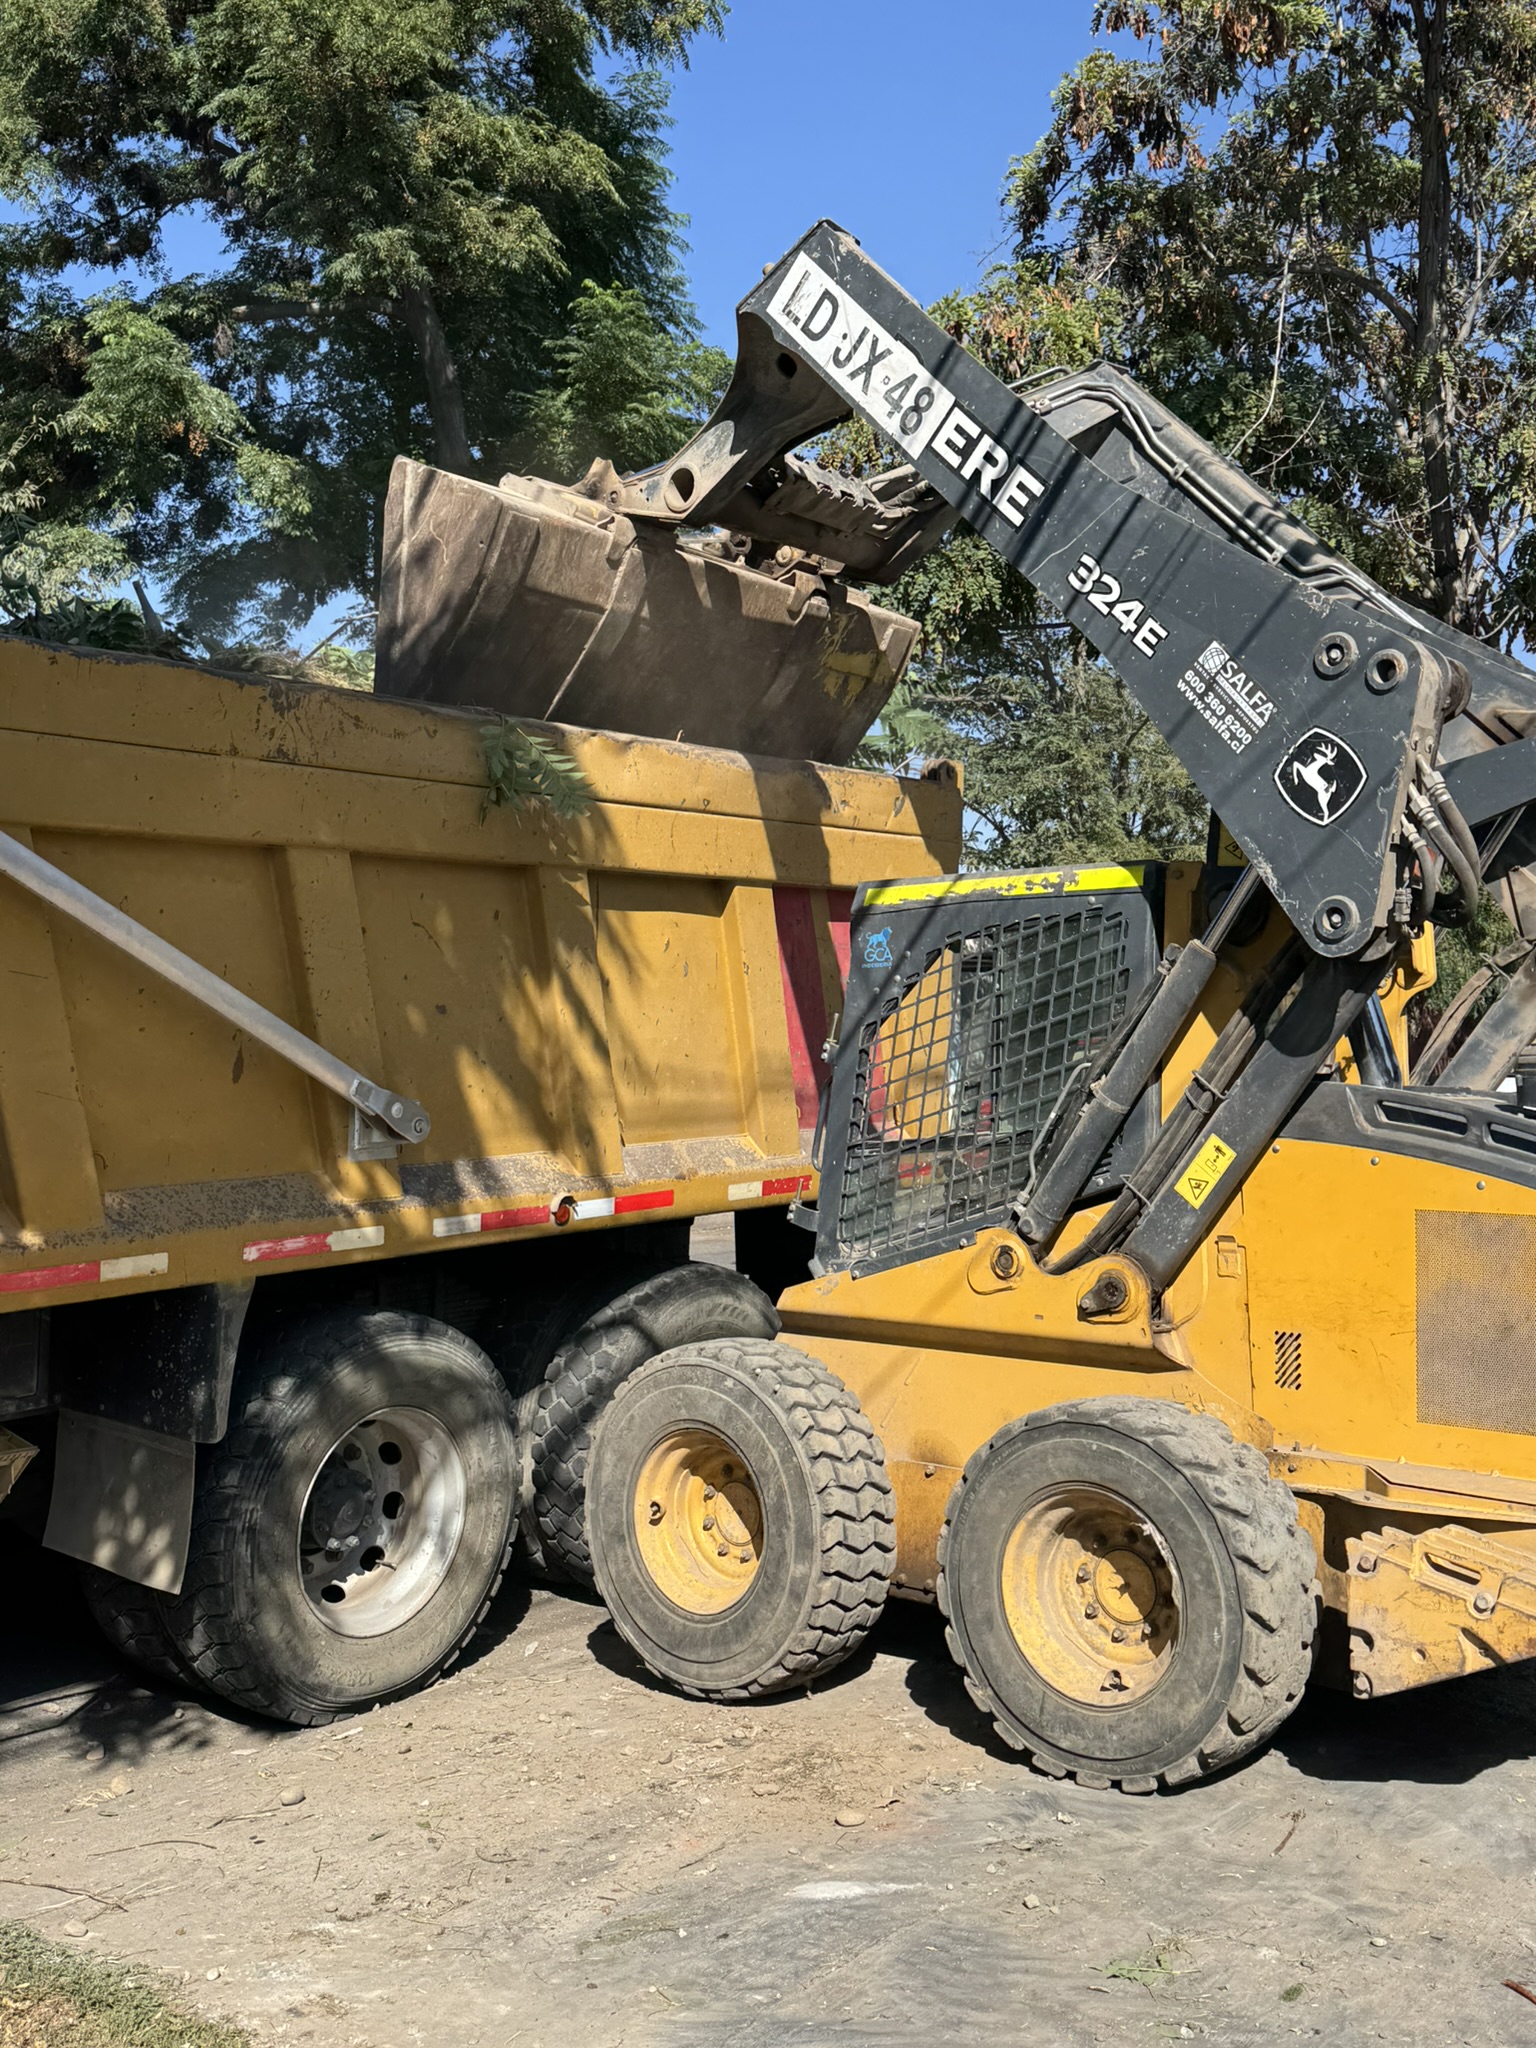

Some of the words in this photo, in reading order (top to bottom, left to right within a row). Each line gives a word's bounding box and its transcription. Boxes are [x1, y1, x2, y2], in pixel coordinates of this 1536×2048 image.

[930, 406, 1046, 528] ERE
[1066, 553, 1169, 659] 324E
[1184, 669, 1206, 693] 600
[1204, 691, 1226, 716] 360
[1224, 714, 1252, 744] 6200
[1193, 661, 1210, 680] VENTAS
[1220, 660, 1274, 722] SALFA
[1176, 679, 1245, 754] www.salfa.cl
[864, 946, 893, 962] GCA
